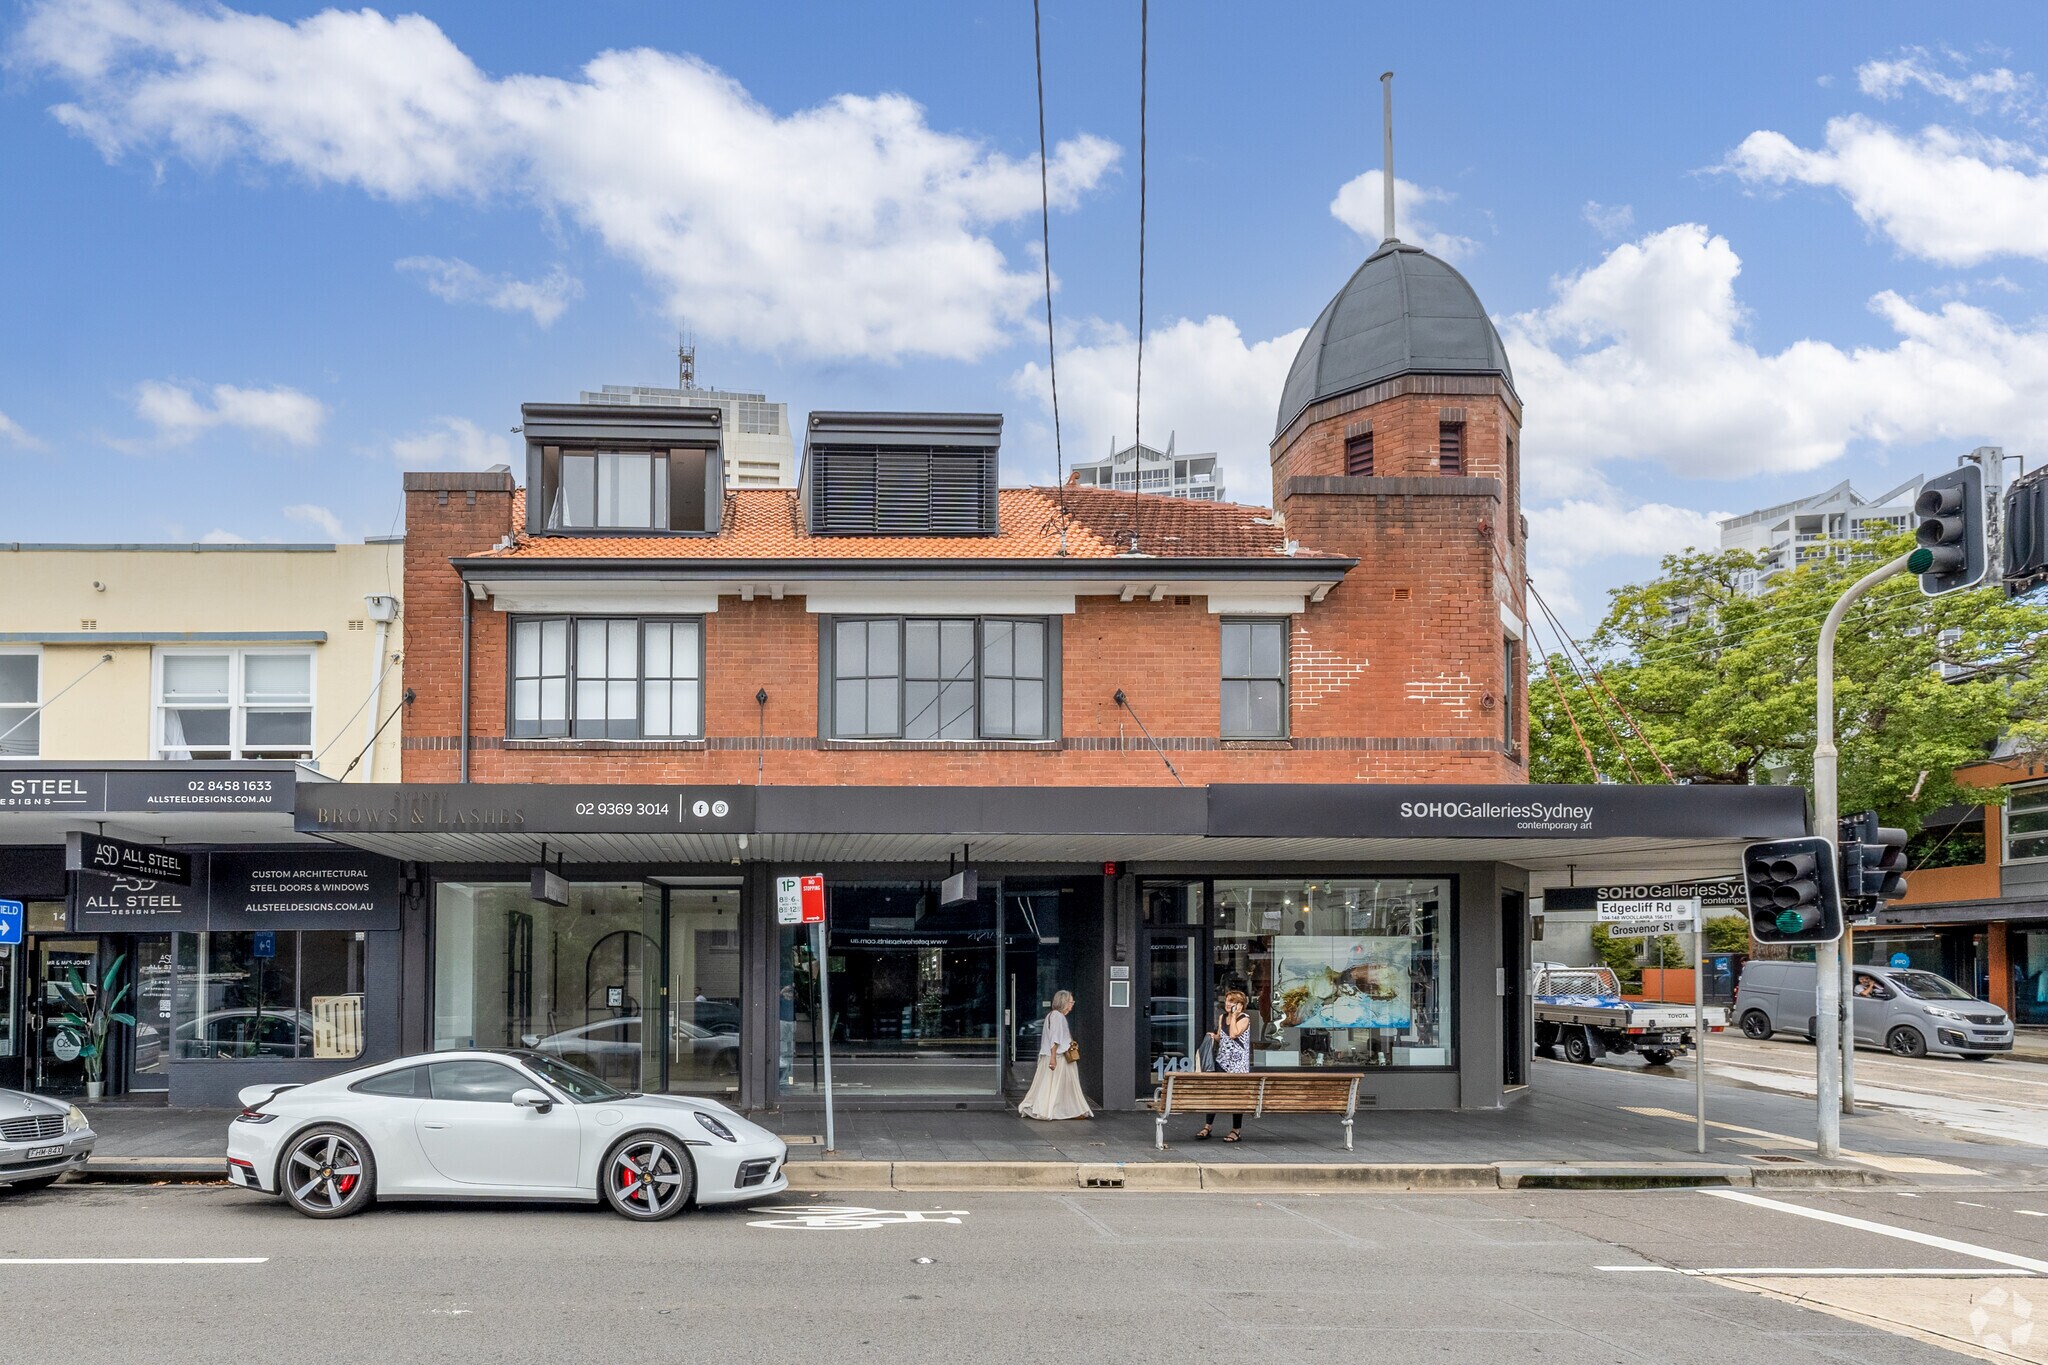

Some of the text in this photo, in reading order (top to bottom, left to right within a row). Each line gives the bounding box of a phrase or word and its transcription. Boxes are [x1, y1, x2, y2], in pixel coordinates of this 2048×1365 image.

[10, 780, 87, 795] STEEL
[188, 781, 272, 791] 02 8458 1633
[0, 798, 51, 806] ESIGNS
[147, 795, 272, 803] ALLSTEELDESIGNS.COM.AU
[575, 802, 669, 815] 02 9369 3014
[1400, 802, 1593, 822] SOHOGalleriesSydney
[317, 808, 525, 824] BROWS & LASHES
[1517, 821, 1592, 831] contemporary art
[94, 843, 181, 870] ASD ALL STEEL
[139, 866, 167, 876] DESIGNS
[252, 870, 368, 878] CUSTOM ARCHITECTURAL
[250, 884, 277, 892] STEEL
[280, 884, 312, 892] DOORS
[322, 883, 369, 891] WINDOWS
[782, 879, 795, 891] 1P
[86, 895, 182, 907] ALL STEEL
[1703, 897, 1746, 906] contempo
[0, 905, 18, 915] IELD
[245, 903, 374, 911] ALLSTEELDESIGNS.COM.AU
[1602, 902, 1672, 915] Edgecliff Rd
[1612, 922, 1674, 935] Grosvenor St
[1153, 1056, 1193, 1080] 148
